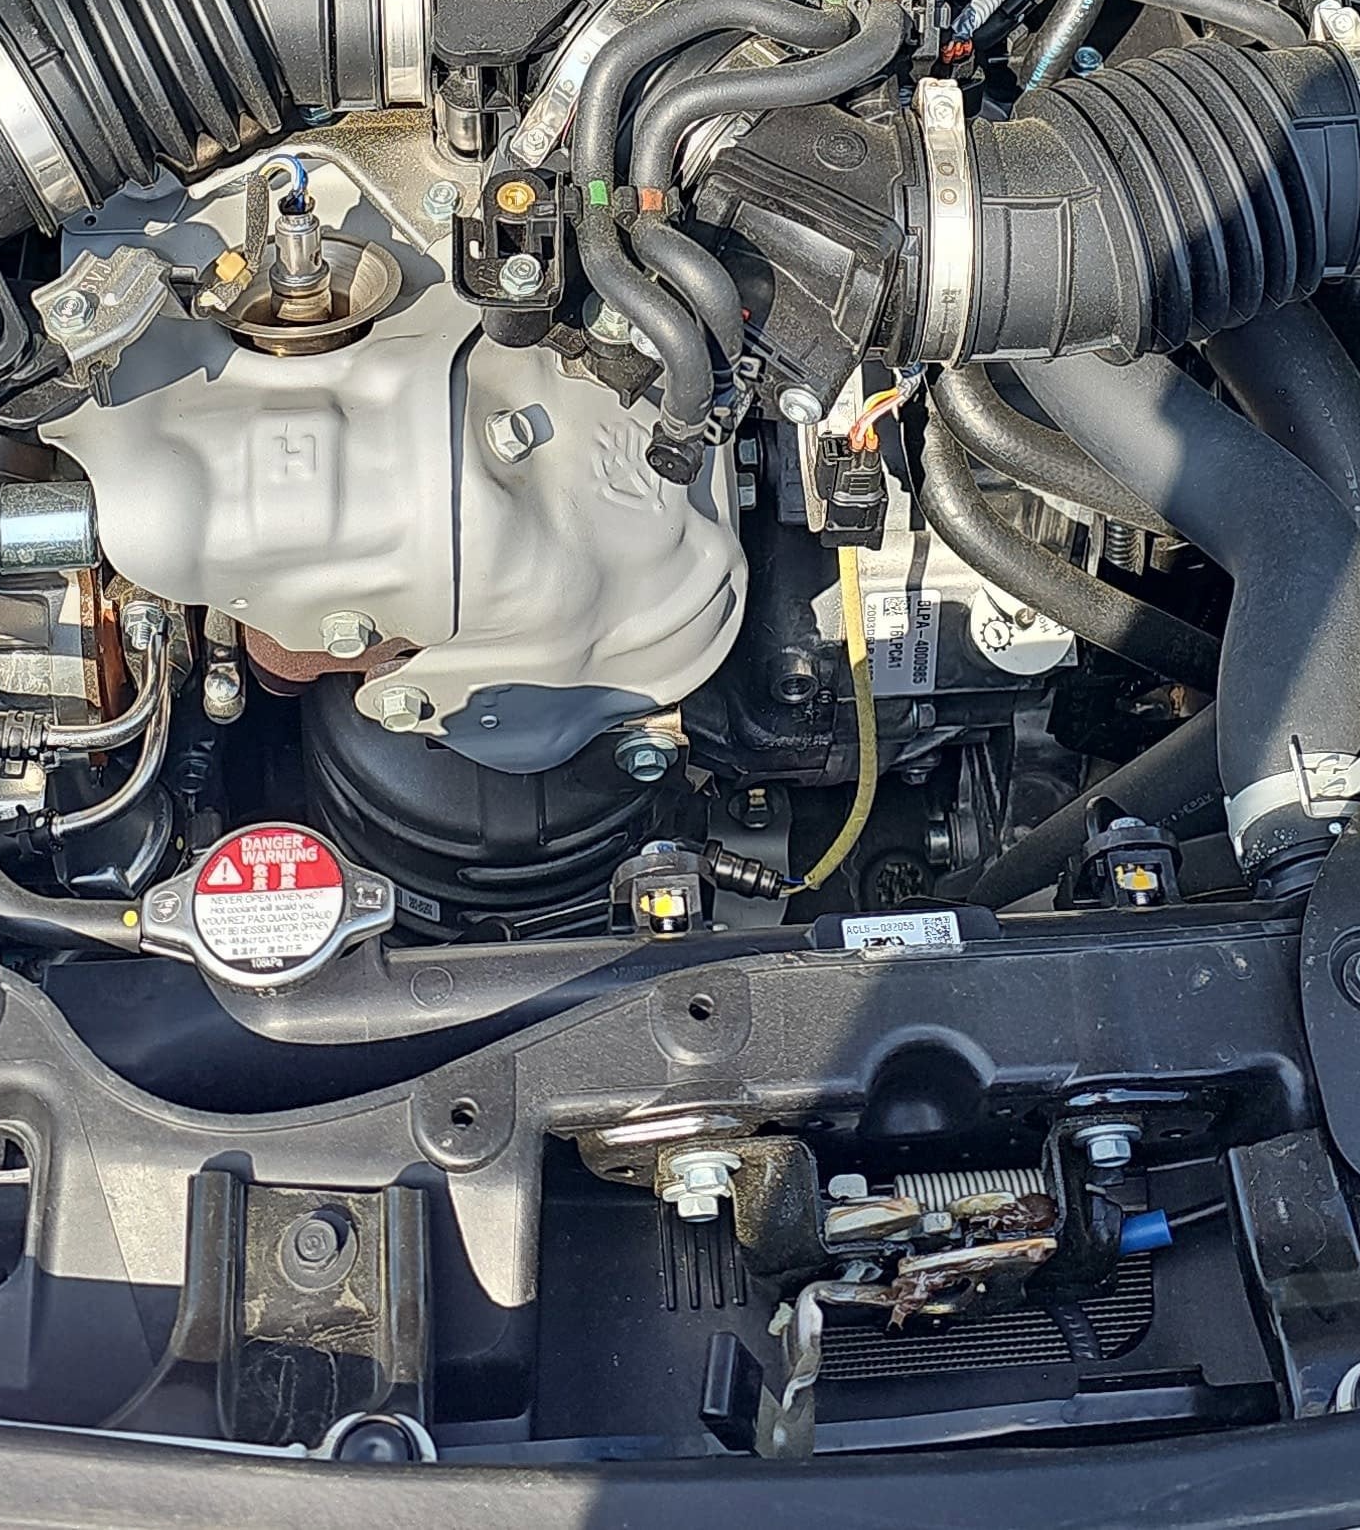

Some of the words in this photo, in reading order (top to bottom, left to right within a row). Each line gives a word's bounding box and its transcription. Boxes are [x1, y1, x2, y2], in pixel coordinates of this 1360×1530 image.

[241, 836, 304, 851] DANGER
[241, 846, 319, 865] WARNUNG
[211, 895, 242, 905] NEVER
[245, 894, 271, 903] OPEN
